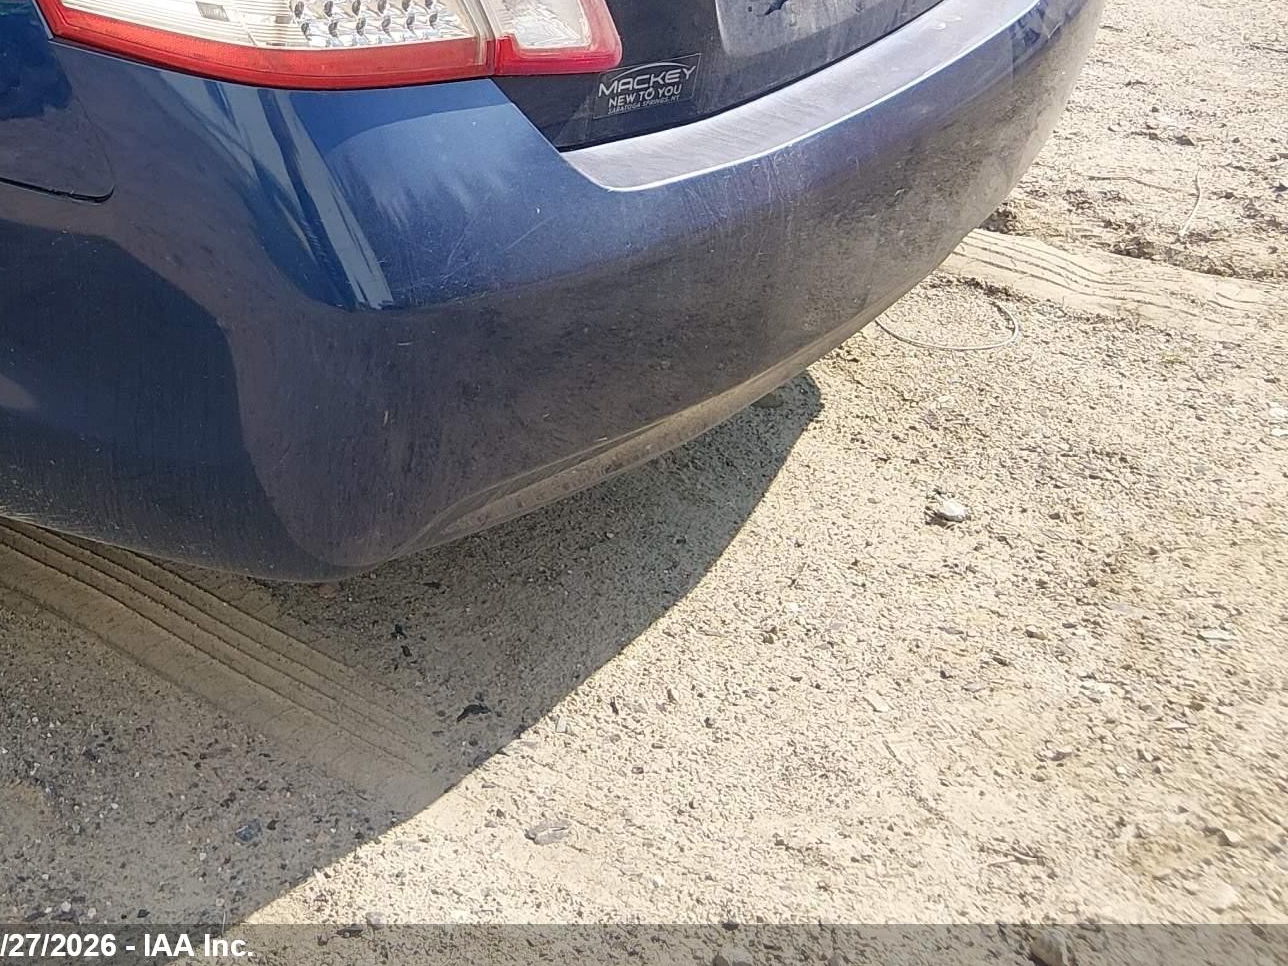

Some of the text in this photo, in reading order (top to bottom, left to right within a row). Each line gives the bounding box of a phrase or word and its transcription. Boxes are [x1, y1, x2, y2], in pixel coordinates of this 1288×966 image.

[598, 65, 696, 97] MACKEY
[607, 101, 641, 115] SARATOGA
[608, 84, 683, 108] NEW TO YOU
